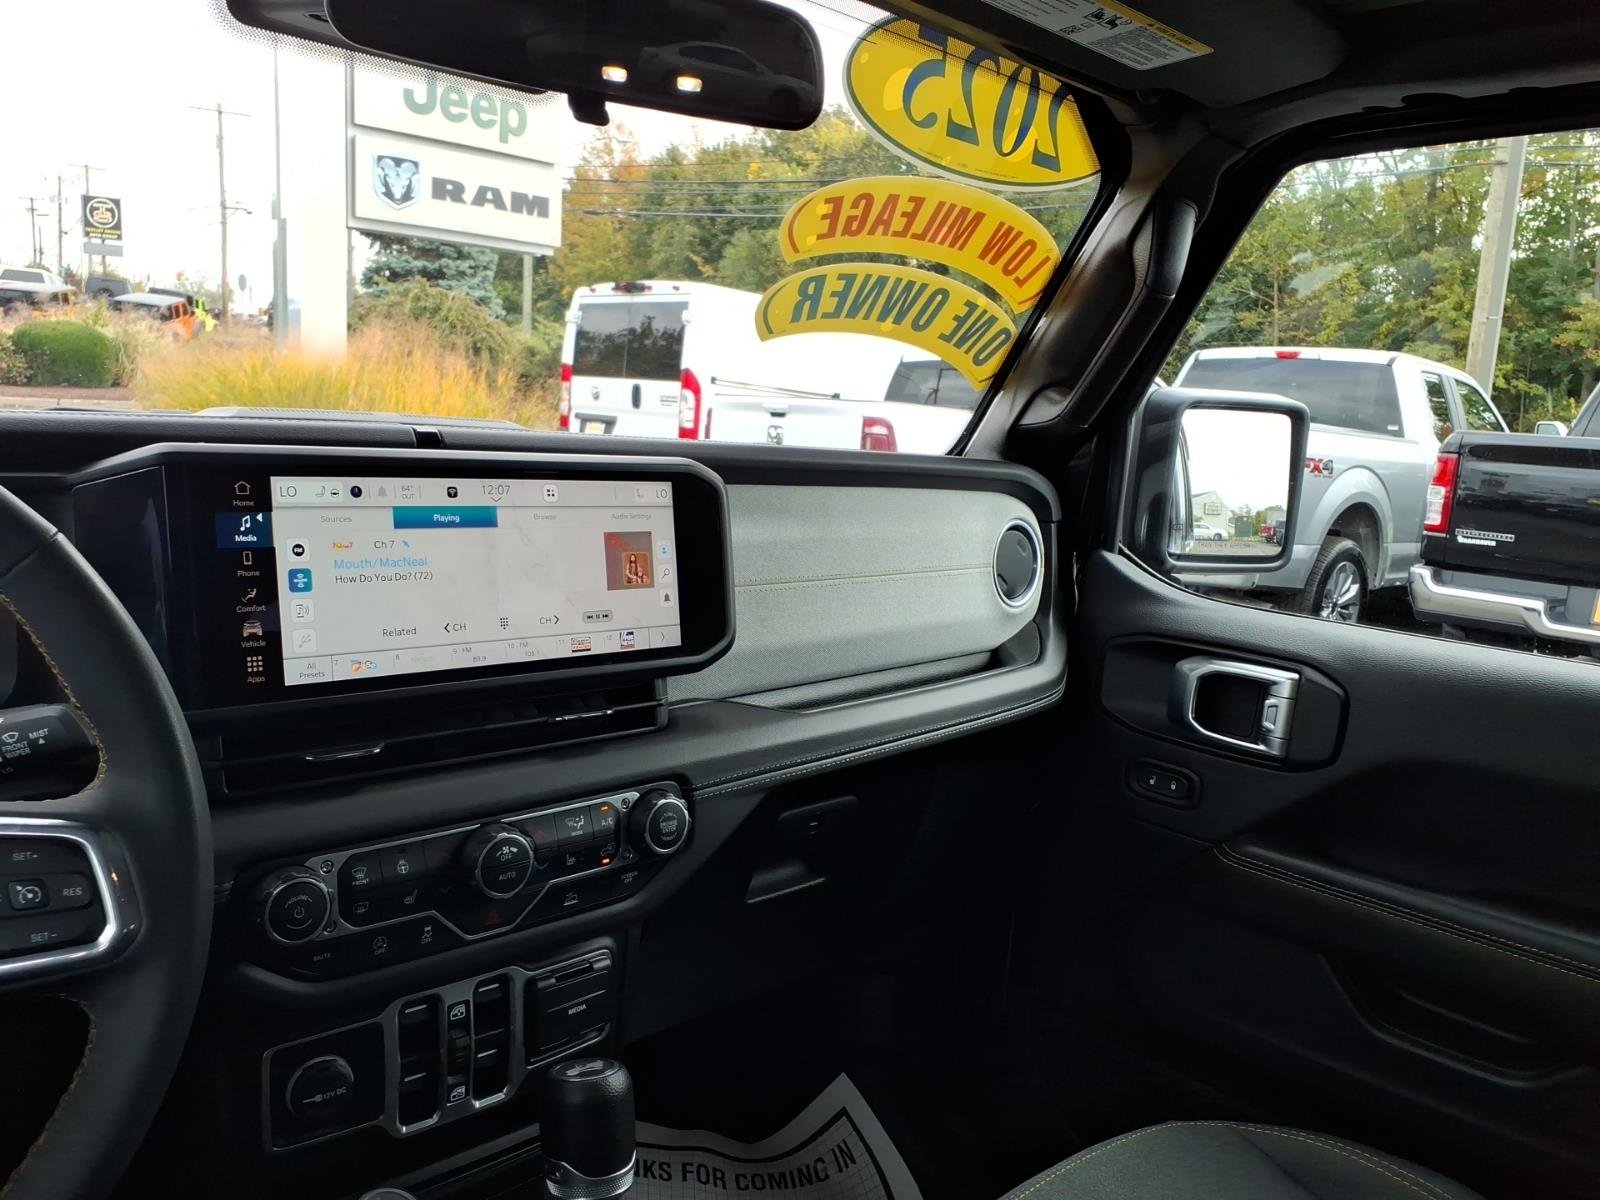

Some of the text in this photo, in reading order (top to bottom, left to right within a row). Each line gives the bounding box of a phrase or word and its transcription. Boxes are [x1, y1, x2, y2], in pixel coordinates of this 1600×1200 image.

[403, 72, 527, 144] Jeep
[431, 176, 550, 219] RAM
[279, 485, 297, 498] LO
[481, 484, 511, 496] 12:07
[232, 499, 255, 507] Home
[320, 515, 353, 523] Sources
[433, 513, 460, 523] Playing
[533, 513, 557, 521] Browse
[234, 534, 257, 542] Media
[373, 540, 395, 549] Ch 7
[237, 569, 260, 577] Phone
[335, 571, 433, 584] How Do You Do? (72)
[236, 603, 266, 613] Comfort
[540, 616, 552, 625] CH
[382, 626, 417, 637] Related
[452, 623, 467, 632] CH
[240, 639, 267, 648] Vehicle
[247, 675, 266, 684] Apps
[299, 670, 326, 679] Presets
[29, 727, 49, 740] MIST
[1, 740, 29, 753] FRONT
[4, 748, 31, 759] WIPER
[601, 817, 614, 828] A/C
[500, 853, 513, 862] OFF
[498, 870, 517, 881] AUTO
[62, 886, 83, 897] RES
[568, 1003, 587, 1015] MEDIA
[336, 1086, 348, 1096] DC
[681, 1161, 727, 1190] FOR
[735, 1156, 830, 1192] COMING
[830, 1138, 857, 1174] IN
